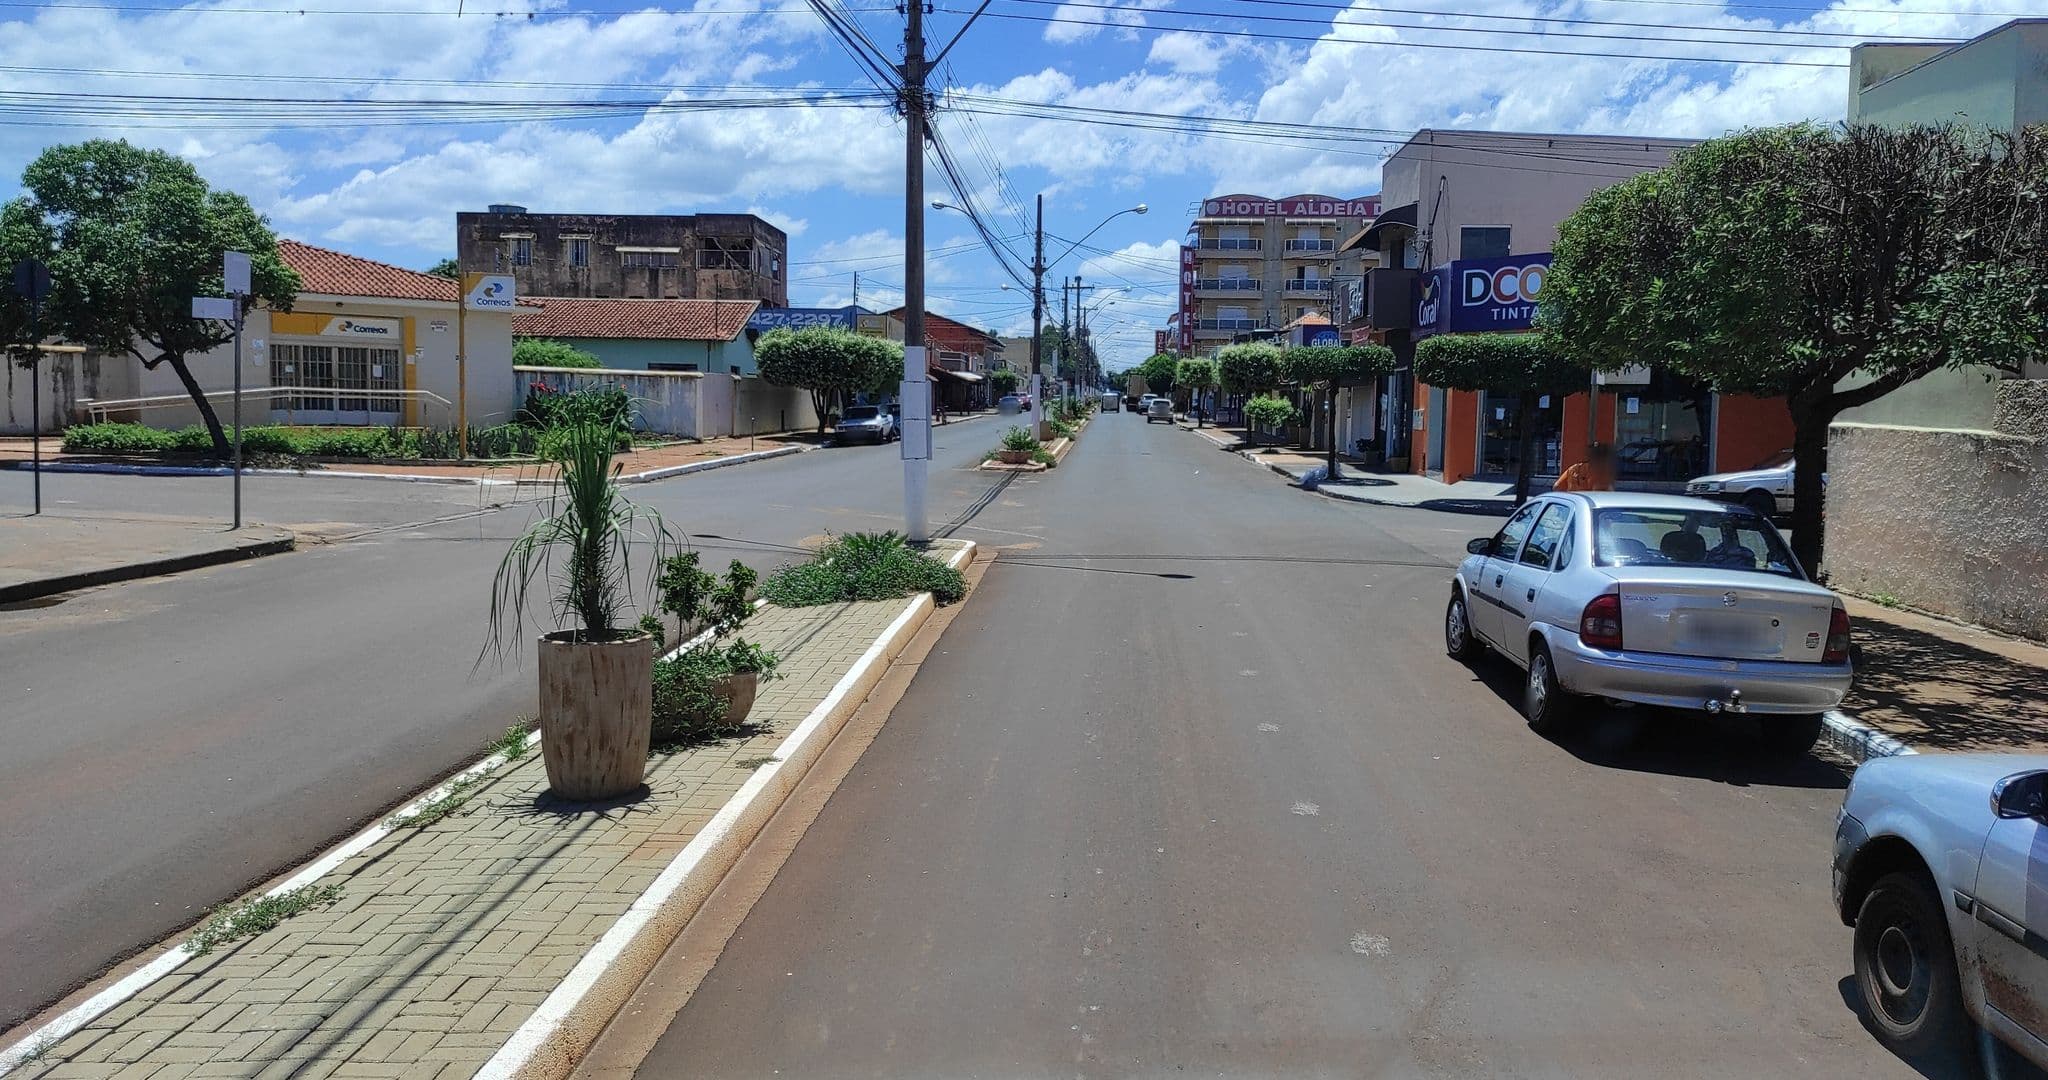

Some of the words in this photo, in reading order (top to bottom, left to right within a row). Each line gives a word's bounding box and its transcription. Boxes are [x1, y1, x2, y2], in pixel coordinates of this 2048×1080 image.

[1221, 202, 1288, 216] HOTEL
[476, 297, 511, 307] Correios
[1183, 250, 1193, 346] HOTEL
[1418, 297, 1437, 327] Coral
[353, 324, 388, 334] Correios
[1311, 338, 1344, 348] GLOBAL
